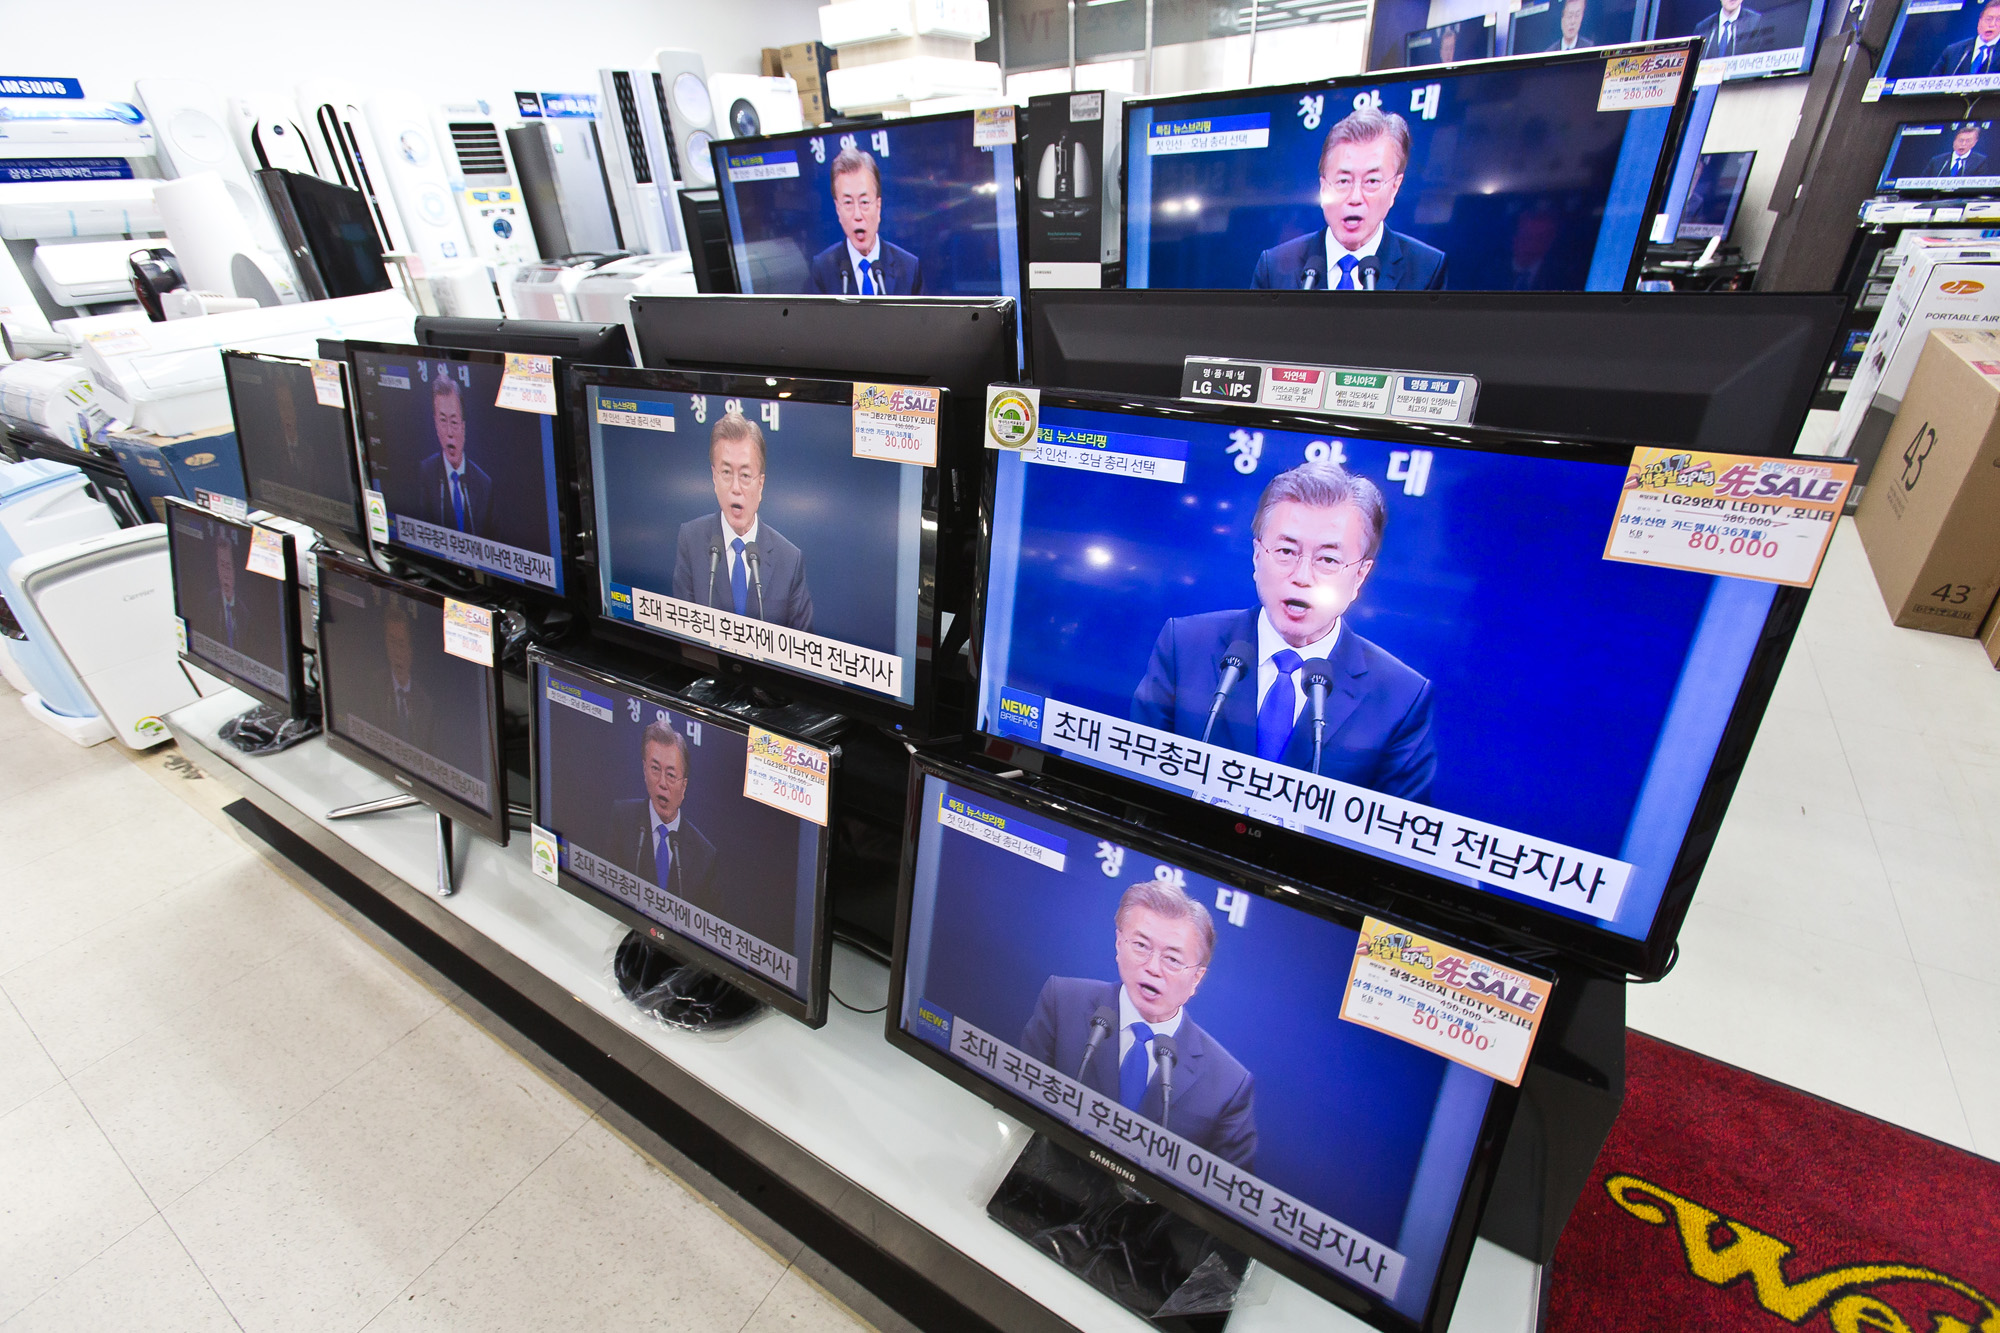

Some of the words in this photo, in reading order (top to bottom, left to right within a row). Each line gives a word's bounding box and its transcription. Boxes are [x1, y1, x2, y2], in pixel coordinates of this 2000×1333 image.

[1410, 83, 1441, 121] 대
[1623, 89, 1663, 100] 290,000
[871, 130, 889, 157] 대
[1925, 313, 1979, 322] PORTABLE
[1980, 315, 2000, 323] AIR
[1192, 380, 1212, 395] LG
[1229, 383, 1252, 398] IPS
[1282, 371, 1307, 382] 자연색
[1343, 375, 1377, 386] 광시야각
[1411, 379, 1429, 391] 명품
[1430, 381, 1450, 392] 패널
[760, 401, 780, 432] 대
[885, 435, 920, 450] 30,000
[1057, 429, 1108, 448] 뉴스브리핑
[1033, 446, 1043, 460] 첫
[1104, 455, 1128, 471] 총리
[1130, 460, 1156, 475] 선택
[1225, 429, 1264, 475] 청
[1386, 449, 1434, 497] 대
[1662, 493, 1725, 511] LG29인치
[401, 520, 415, 540] 초대
[417, 525, 448, 550] 국무총리
[449, 535, 483, 561] 후보자에
[484, 544, 511, 570] 이낙연
[512, 551, 551, 582] 전남지사
[1687, 531, 1779, 559] 80,000
[610, 590, 631, 604] NEWS
[611, 600, 632, 612] BRIEFING
[638, 594, 662, 622] 초대
[665, 602, 715, 637] 국무총리
[719, 616, 774, 654] 후보자에
[778, 632, 823, 668] 이낙연
[827, 645, 893, 687] 전남지사
[1000, 697, 1039, 720] NEWS
[1000, 710, 1038, 730] BRIEFING
[686, 721, 702, 746] 대
[773, 782, 812, 806] 20,000
[948, 798, 964, 815] 특집
[966, 804, 1006, 830] 뉴스브리핑
[1053, 710, 1101, 751] 초대
[1107, 725, 1212, 785] 국무총리
[1217, 758, 1336, 823] 후보자에
[1344, 796, 1444, 855] 이낙연
[1451, 827, 1606, 904] 전남지사
[946, 812, 956, 825] 첫
[1002, 833, 1022, 849] 총리
[1023, 842, 1042, 860] 선택
[1247, 827, 1262, 838] LG
[1095, 840, 1125, 878] 청
[1215, 887, 1250, 928] 대
[573, 850, 595, 877] 초대
[597, 861, 641, 901] 국무총리
[643, 886, 691, 929] 후보자에
[693, 912, 732, 950] 이낙연
[735, 932, 792, 981] 전남지사
[656, 931, 665, 940] LG
[1389, 967, 1446, 997] 삼성23인치
[919, 1006, 949, 1031] NEWS
[1412, 1009, 1489, 1051] 50,000
[960, 1028, 998, 1070] 초대
[1003, 1051, 1083, 1117] 국무총리
[1088, 1101, 1181, 1171] 후보자에
[1187, 1153, 1264, 1217] 이낙연
[1270, 1197, 1388, 1284] 전남지사
[1089, 1150, 1136, 1183] SAMSUNG
